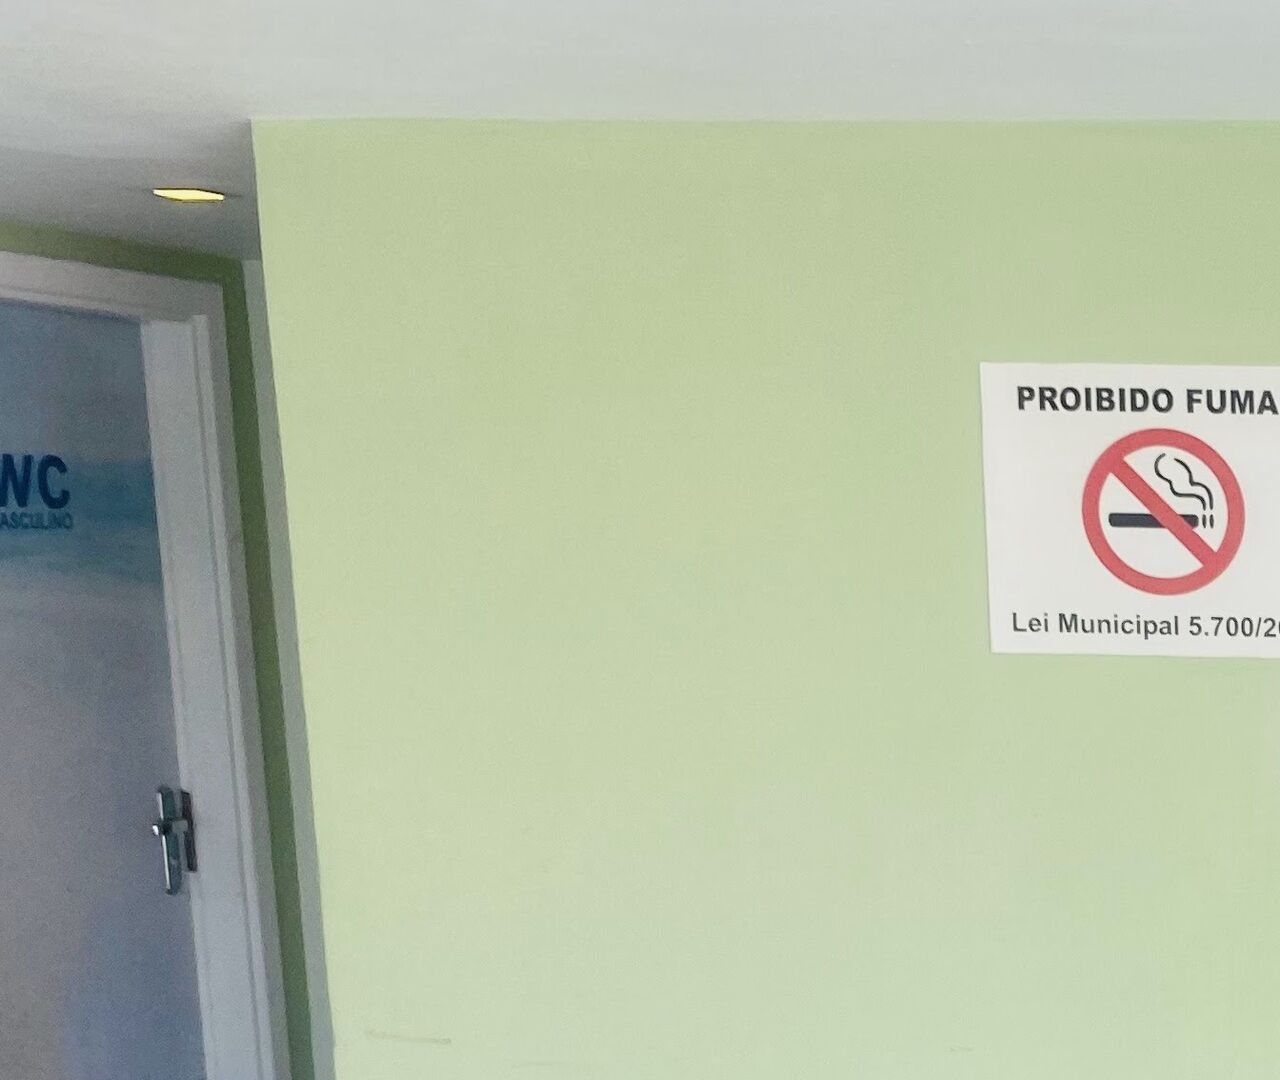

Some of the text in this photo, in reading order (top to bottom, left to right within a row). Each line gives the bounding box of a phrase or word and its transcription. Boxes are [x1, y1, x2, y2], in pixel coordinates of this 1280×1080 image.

[1017, 386, 1174, 413] PROIBIDO
[1012, 613, 1049, 634] Lei
[1059, 613, 1179, 640] Municipal
